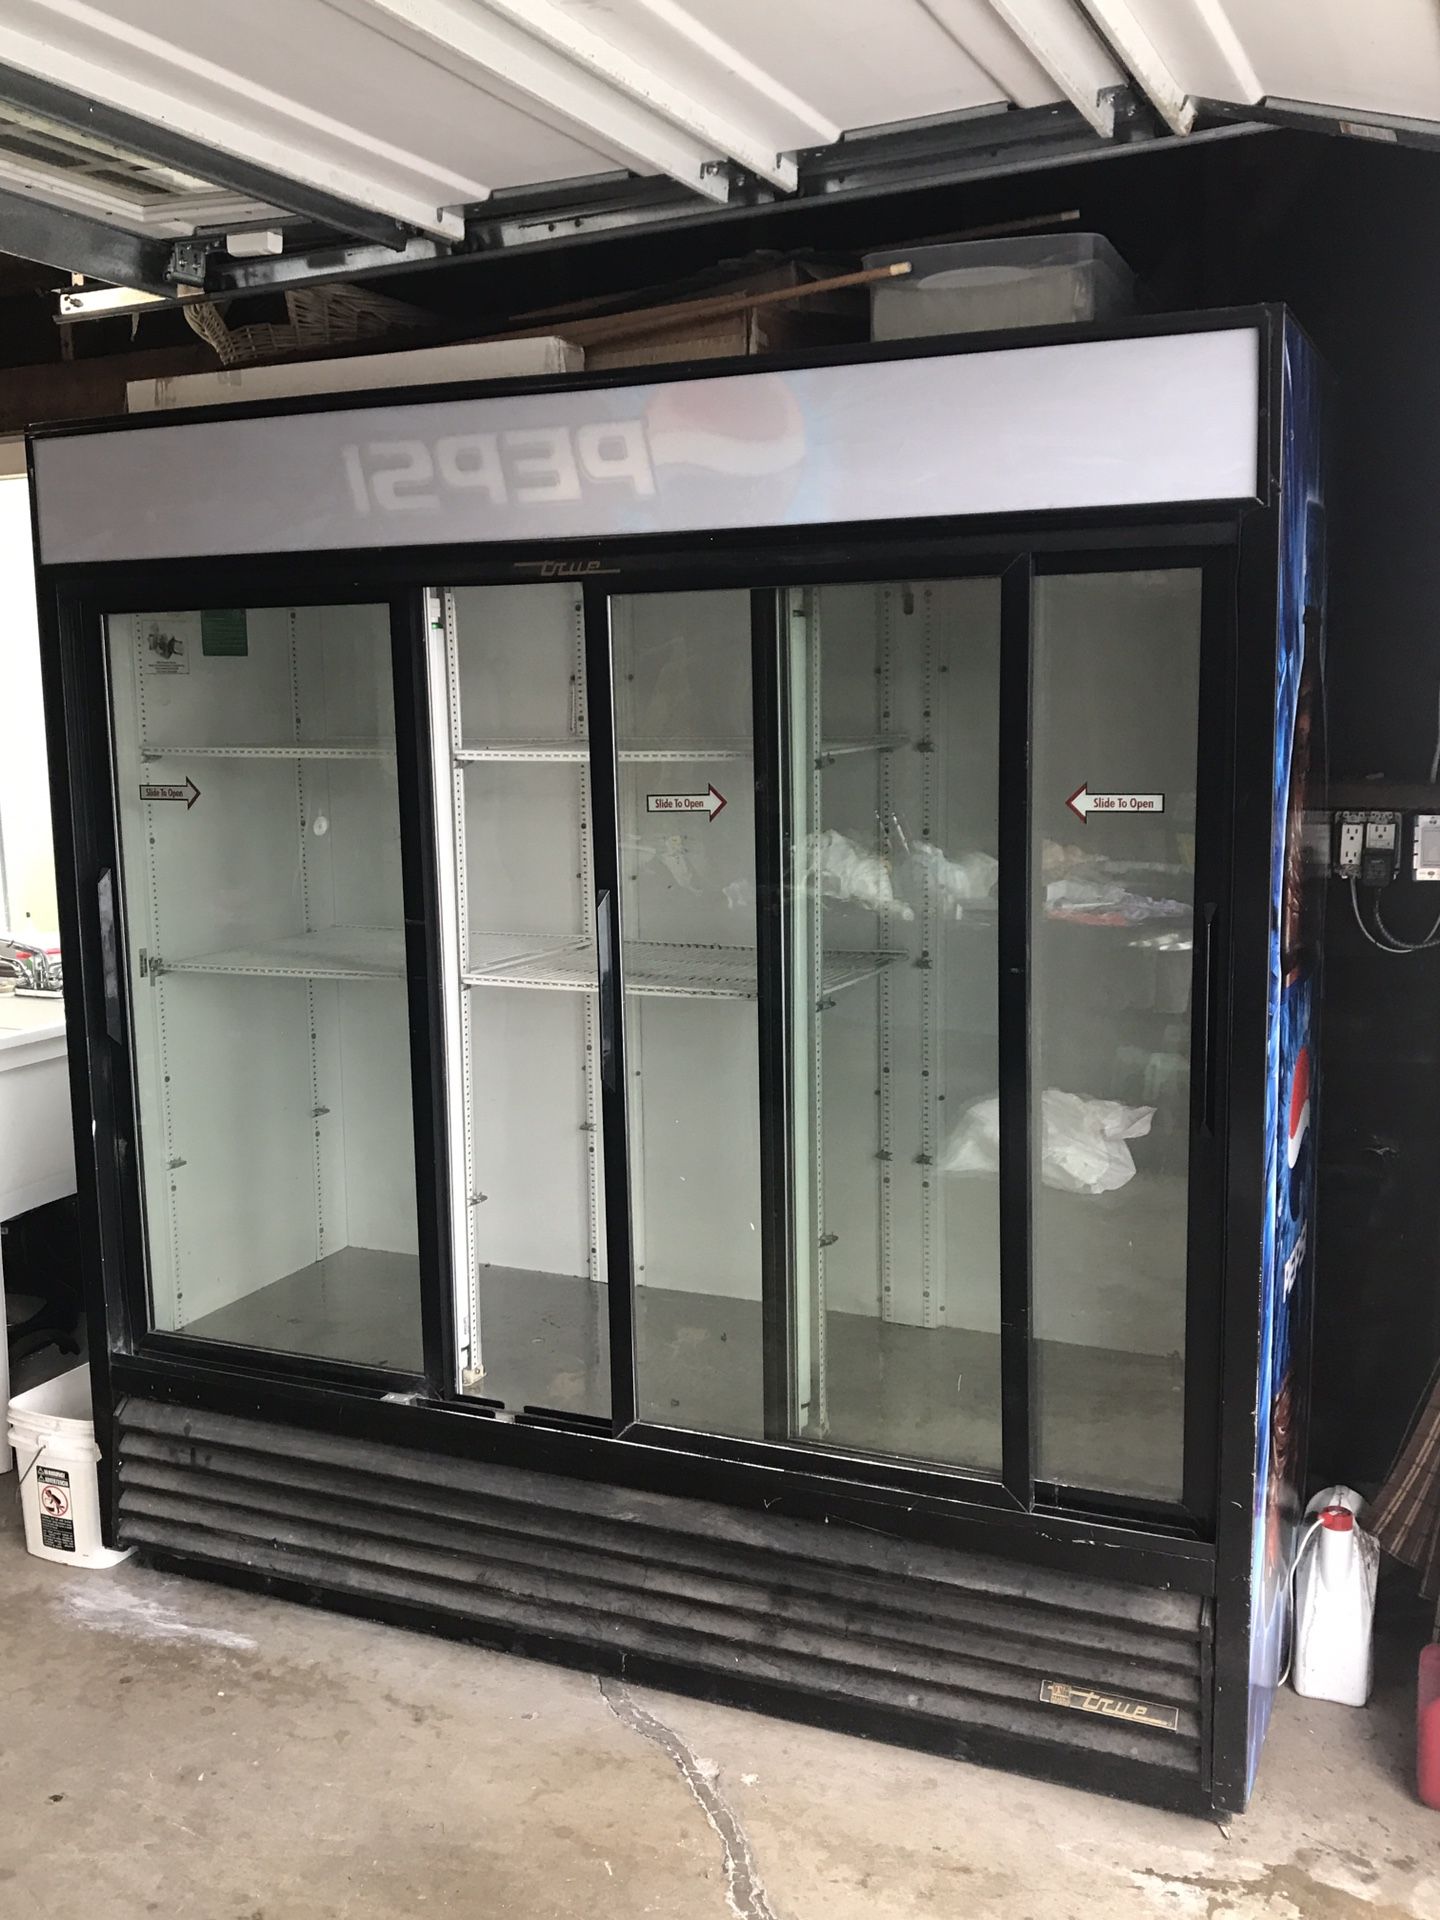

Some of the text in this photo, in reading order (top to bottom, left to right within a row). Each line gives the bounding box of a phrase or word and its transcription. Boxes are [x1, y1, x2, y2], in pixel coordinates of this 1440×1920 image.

[145, 788, 159, 797] Slide
[168, 788, 183, 798] Open
[655, 798, 704, 809] Slide To Open
[1093, 797, 1154, 810] Slide To Open
